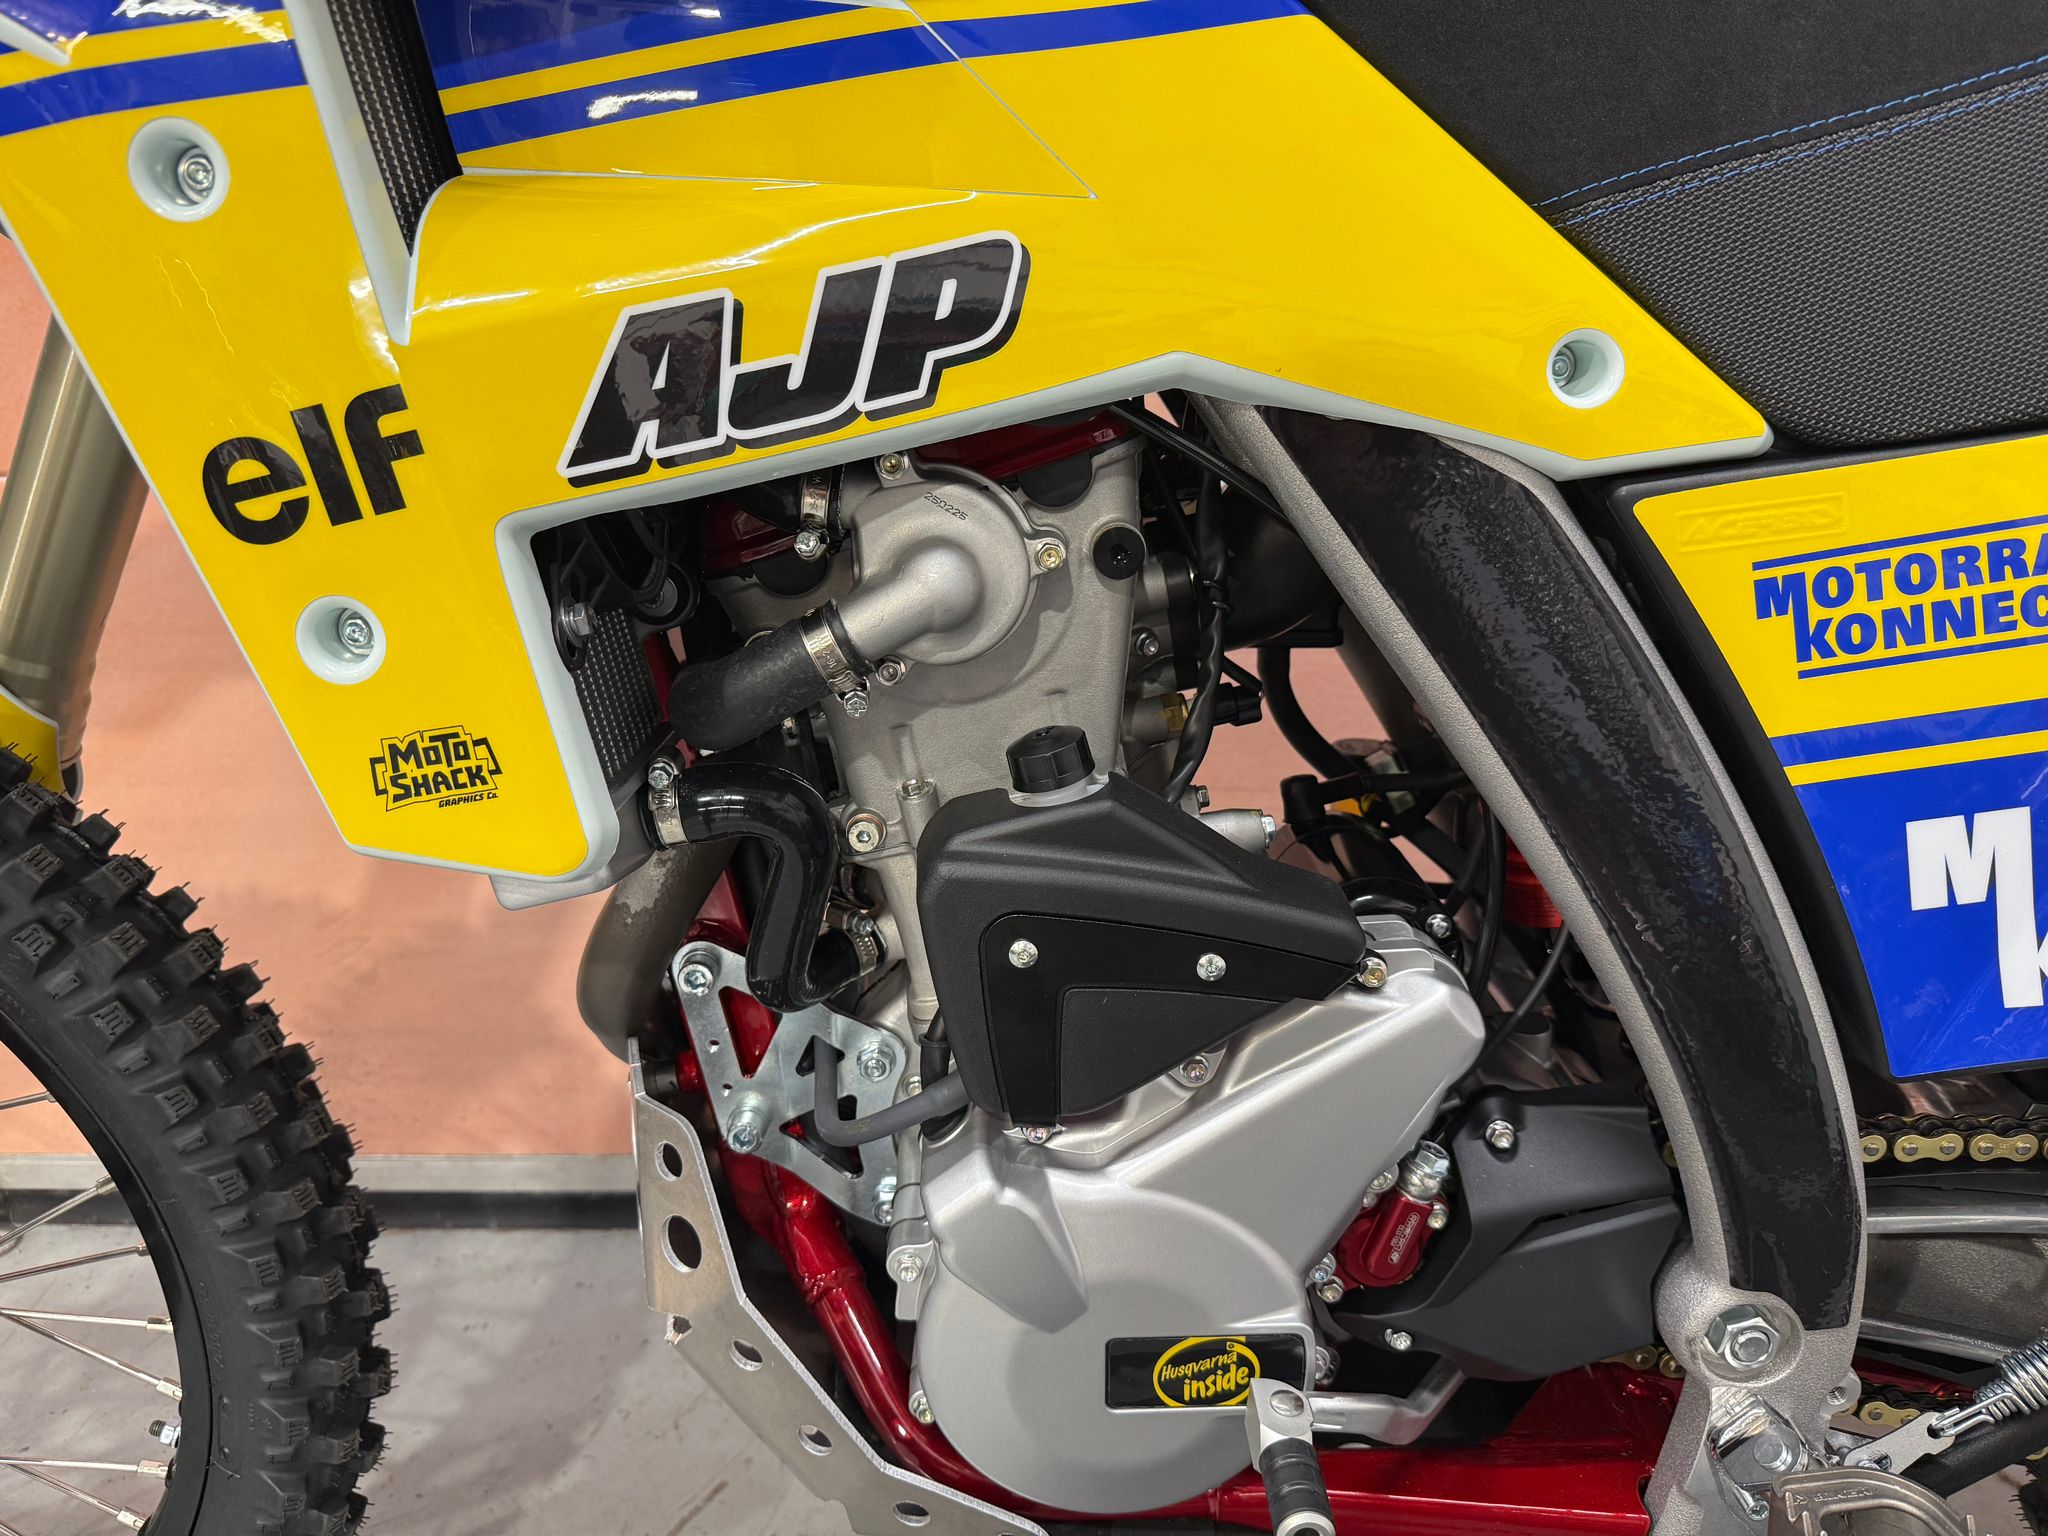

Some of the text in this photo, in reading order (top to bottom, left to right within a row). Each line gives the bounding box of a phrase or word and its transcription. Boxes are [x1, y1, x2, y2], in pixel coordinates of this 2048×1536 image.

[556, 230, 1031, 487] AJP
[202, 384, 425, 546] elf
[924, 491, 969, 521] 250225
[389, 764, 489, 804] SHACK
[438, 793, 485, 808] GRAPHICS
[1160, 1351, 1249, 1401] Husqvarna inside
